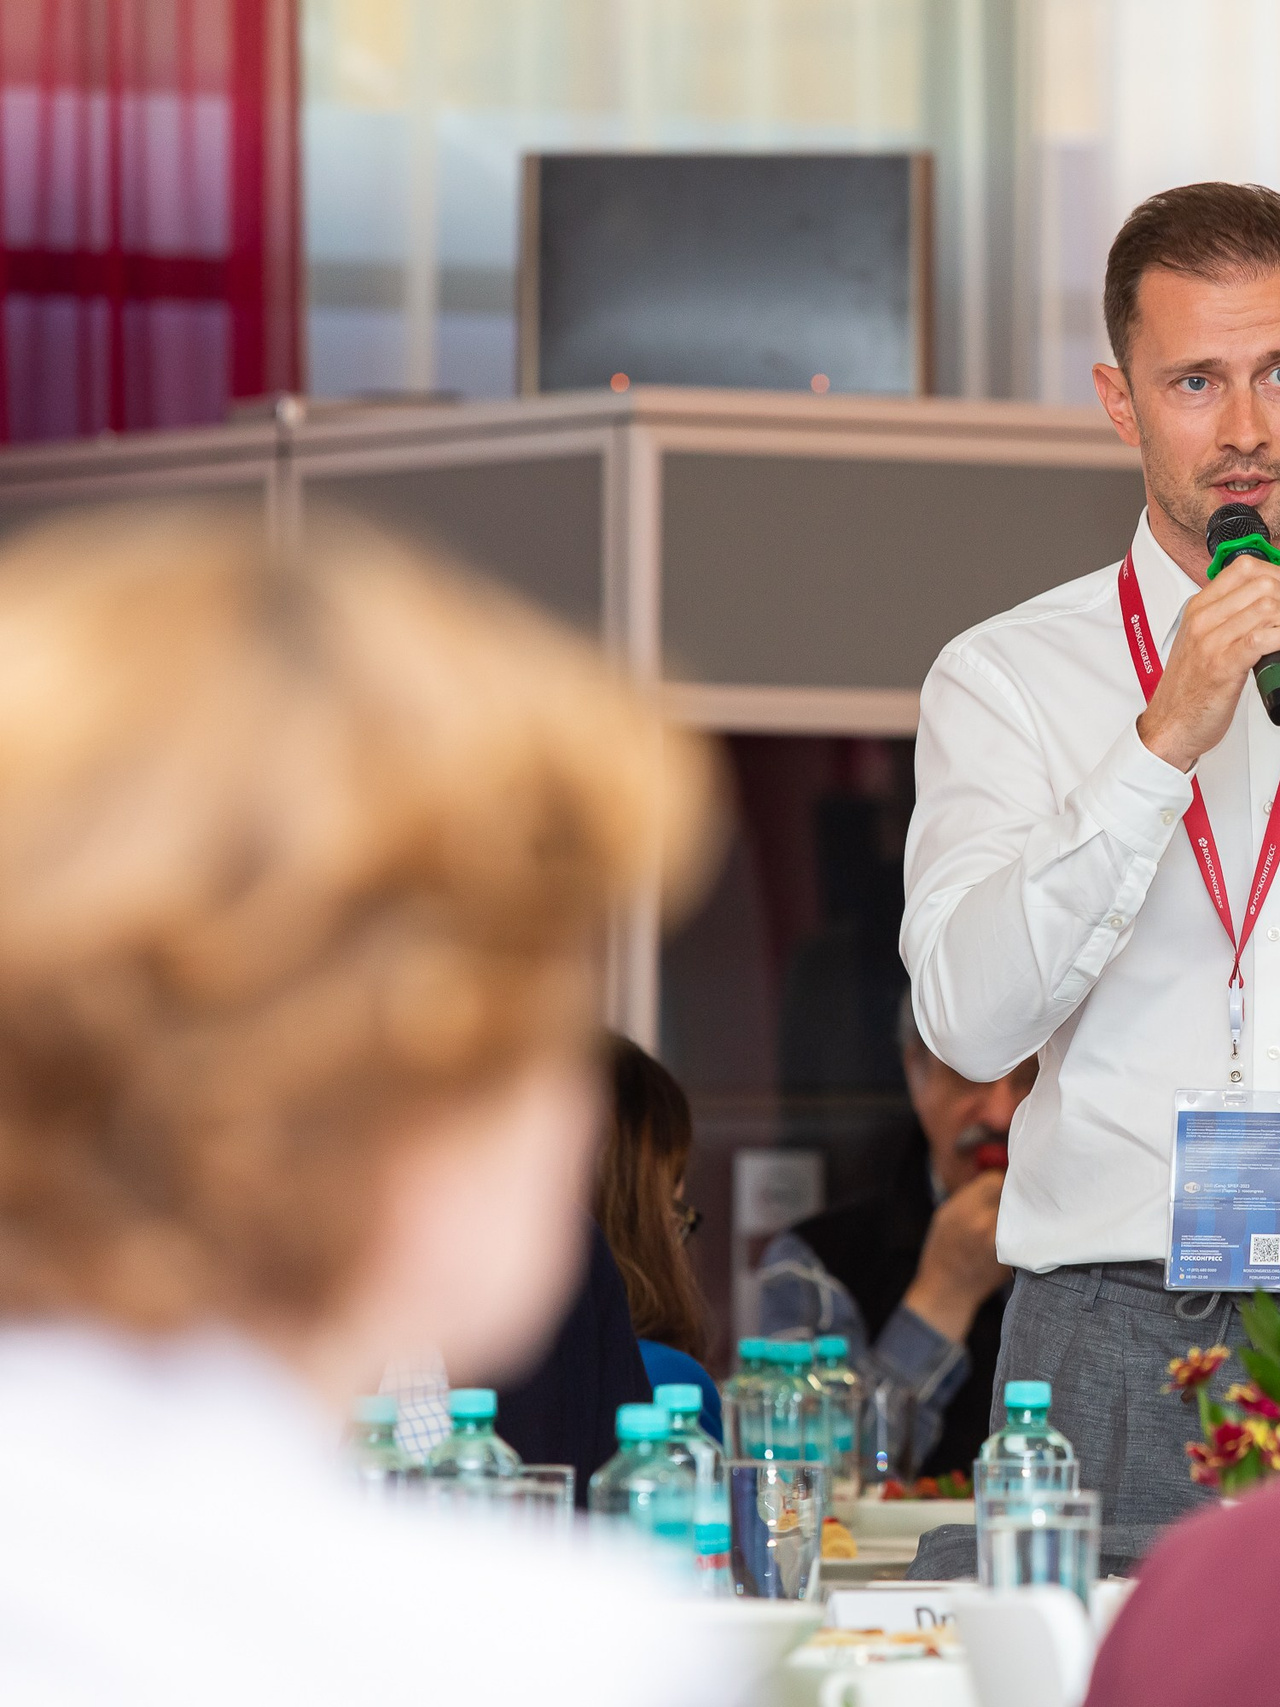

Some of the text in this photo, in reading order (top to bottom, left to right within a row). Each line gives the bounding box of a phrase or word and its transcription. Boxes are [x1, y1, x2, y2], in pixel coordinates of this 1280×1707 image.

[1133, 622, 1154, 674] ROSCONGRESS
[1201, 847, 1223, 909] ROSCONGRESS
[1252, 843, 1277, 906] РОСКОНГРЕСС
